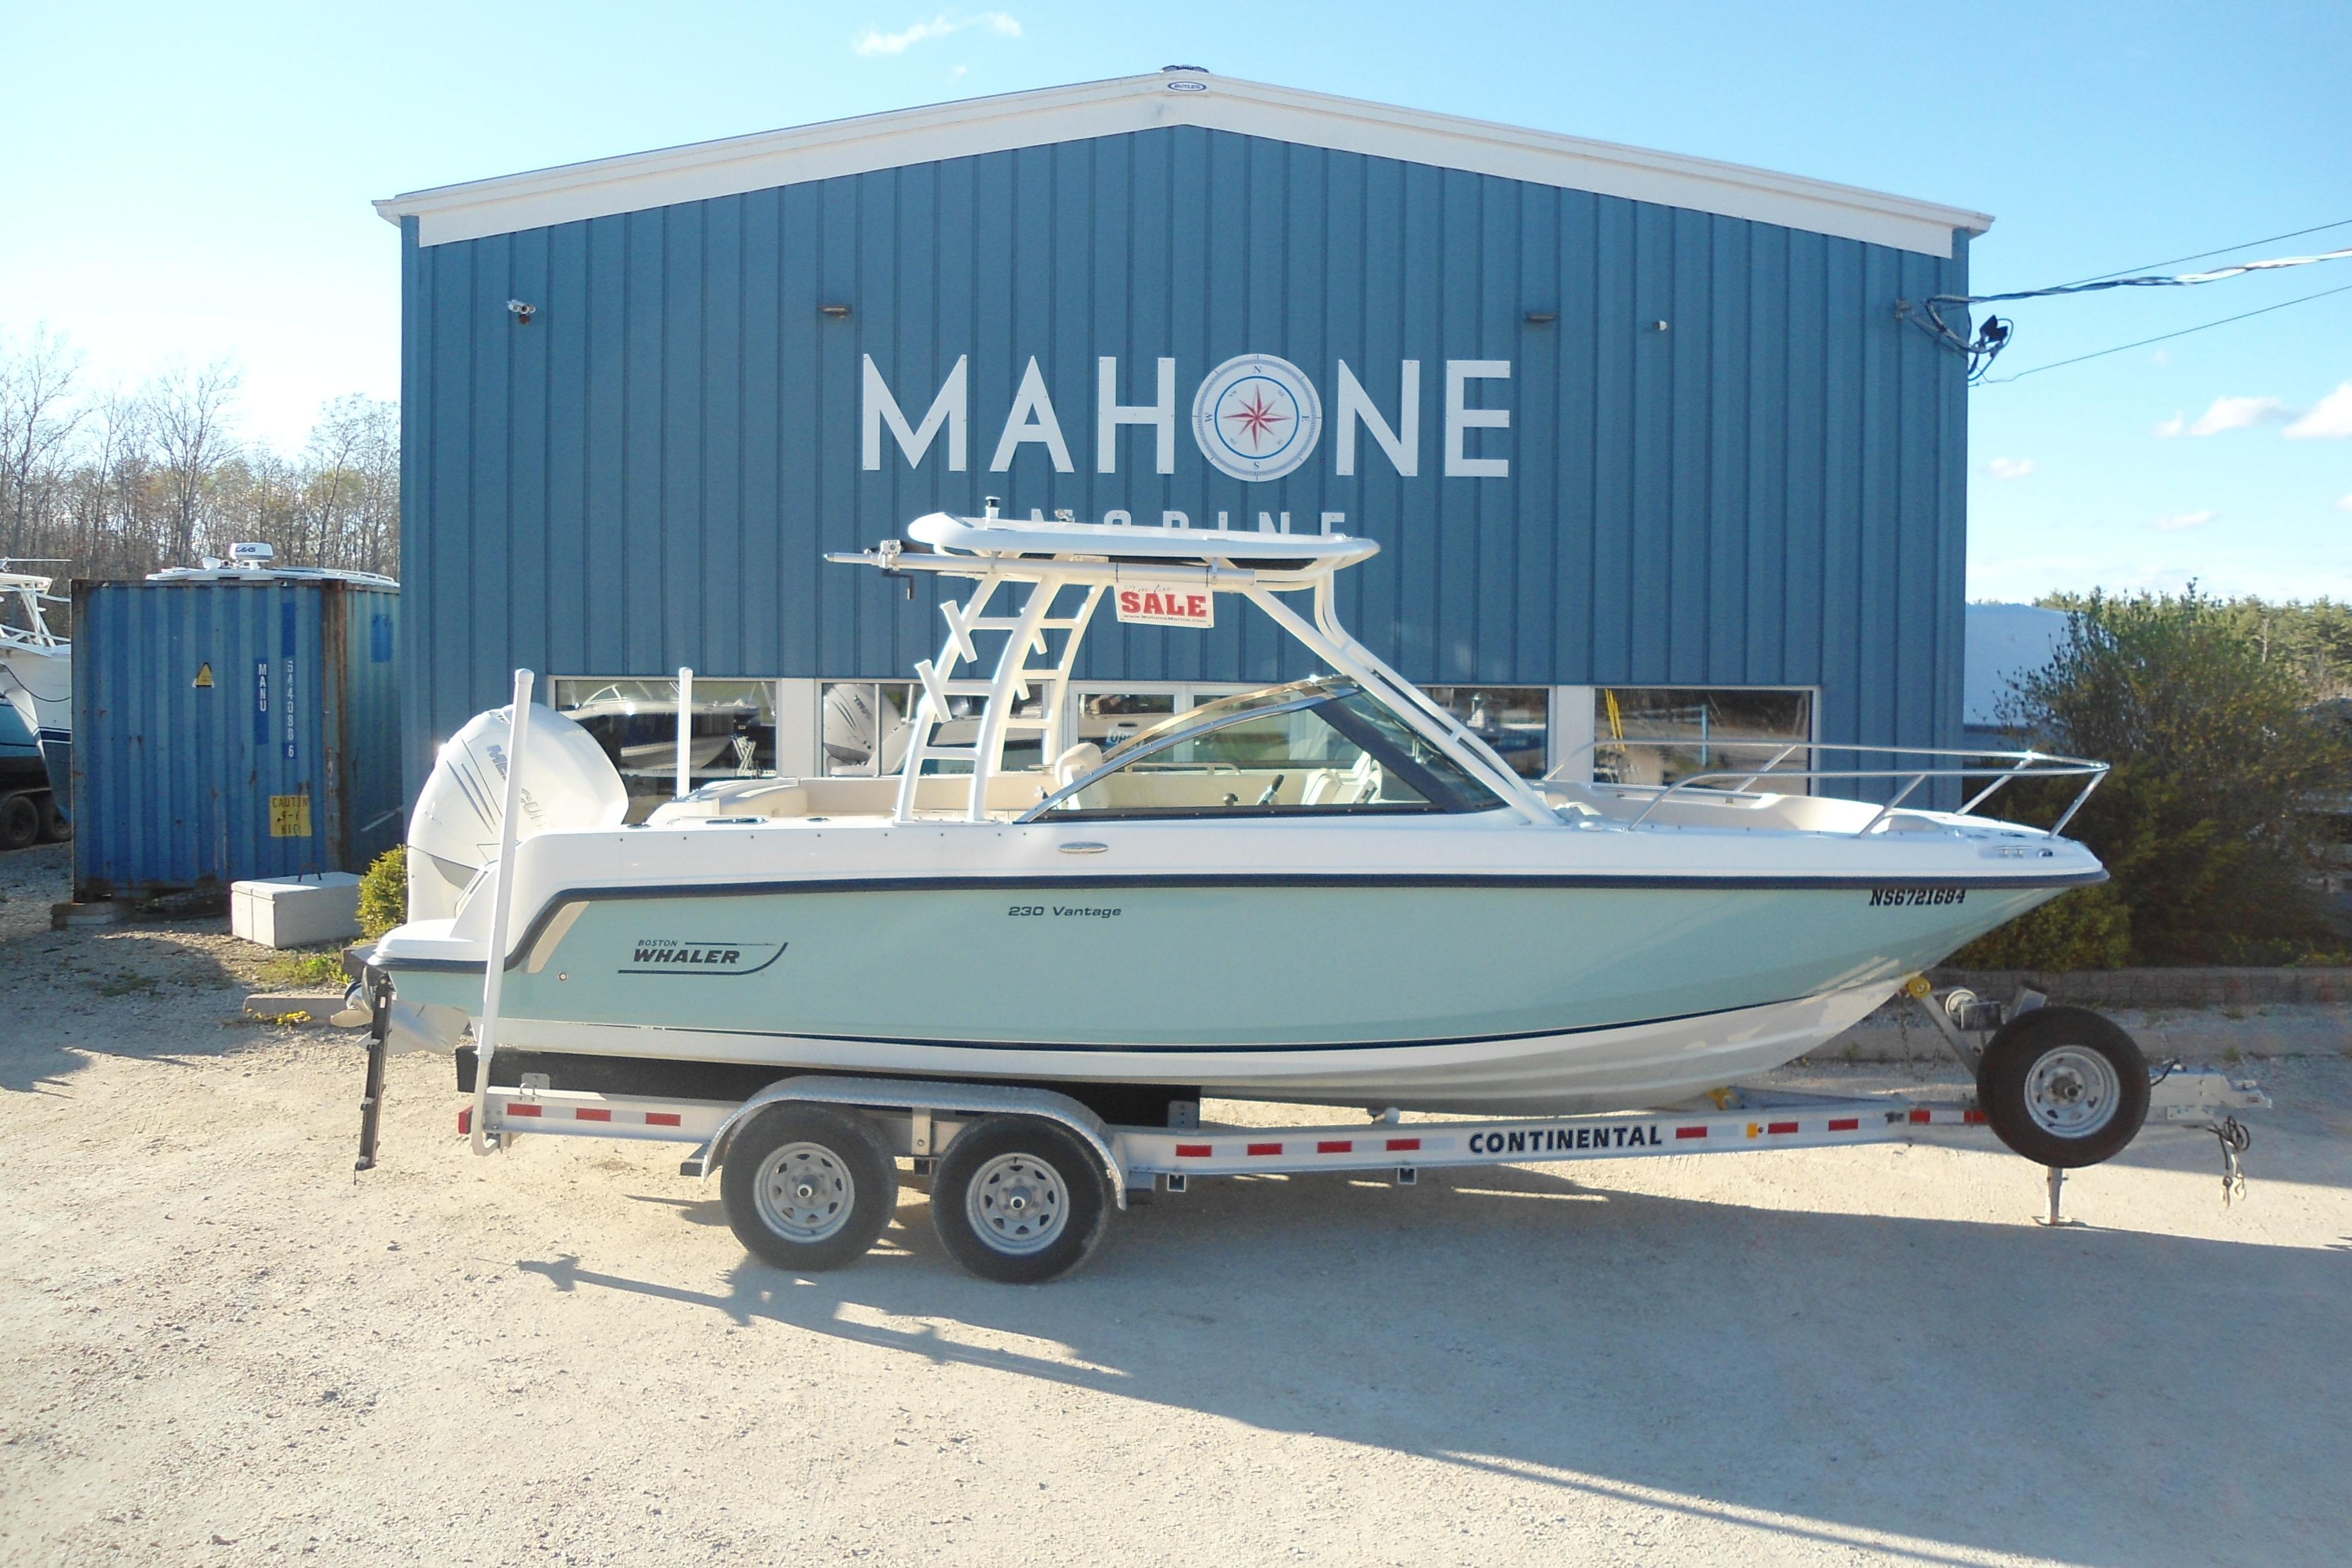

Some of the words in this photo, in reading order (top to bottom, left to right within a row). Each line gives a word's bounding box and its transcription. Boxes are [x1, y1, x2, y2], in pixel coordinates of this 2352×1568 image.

[863, 354, 1510, 482] MAHONE
[1120, 591, 1207, 617] SALE
[258, 664, 267, 711] MANU
[1008, 906, 1044, 917] 230
[1053, 906, 1121, 918] Vantage
[633, 948, 740, 964] WHALER
[1469, 1125, 1662, 1154] CONTINENTAL
